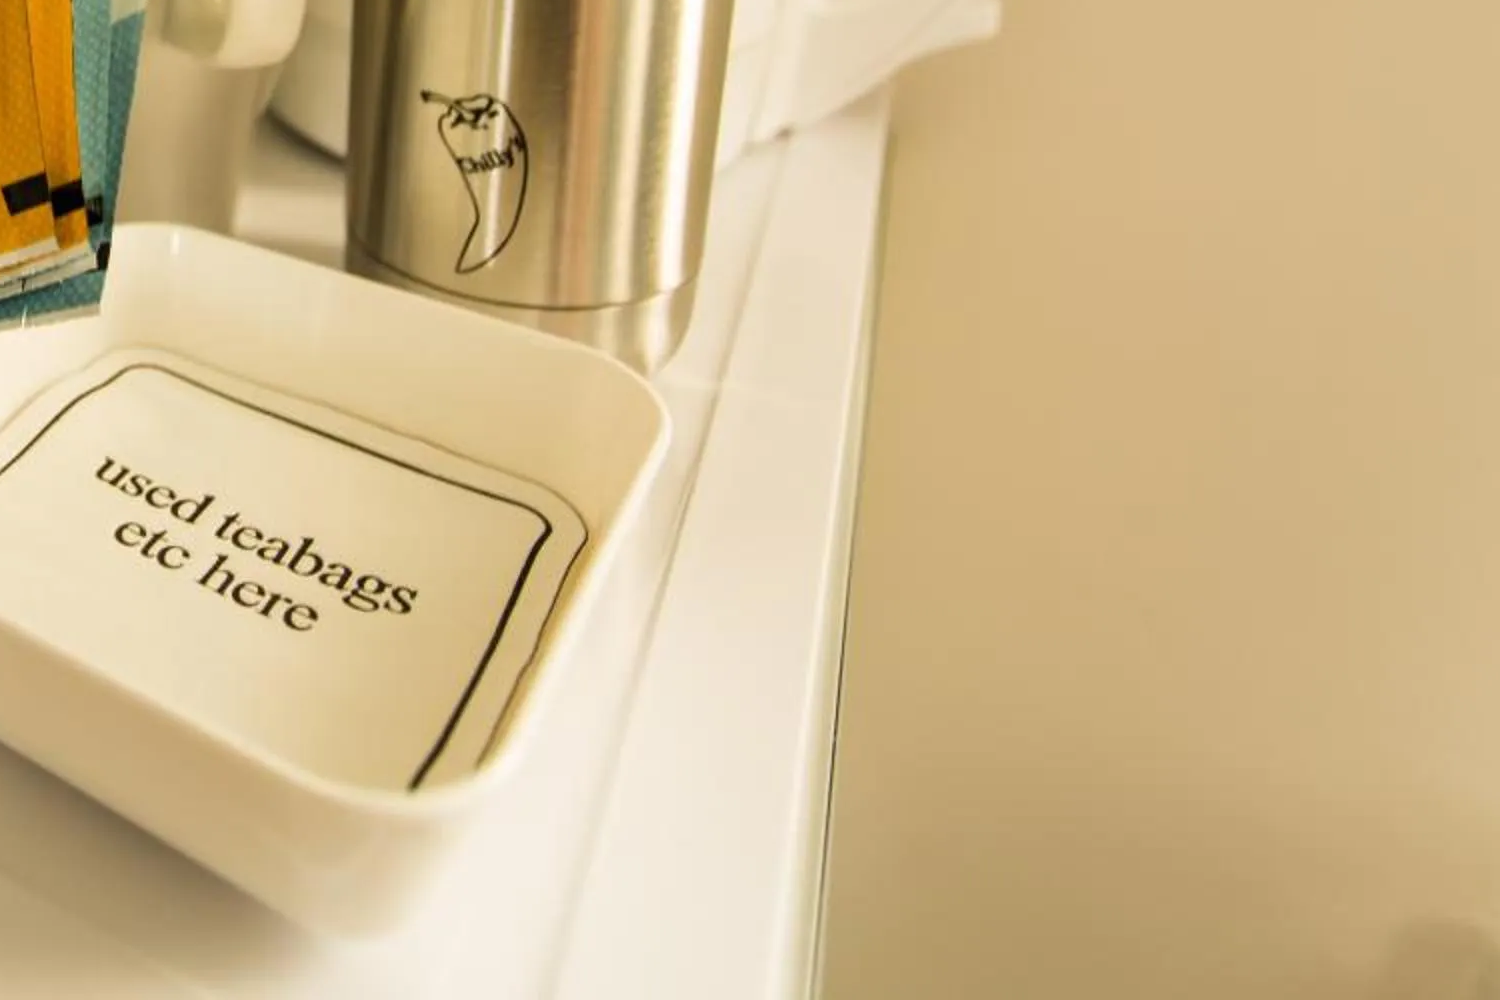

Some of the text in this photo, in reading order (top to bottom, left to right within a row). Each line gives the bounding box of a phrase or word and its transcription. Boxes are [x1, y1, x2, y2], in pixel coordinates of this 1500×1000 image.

[95, 456, 419, 617] used teabags
[113, 520, 321, 633] etc here
